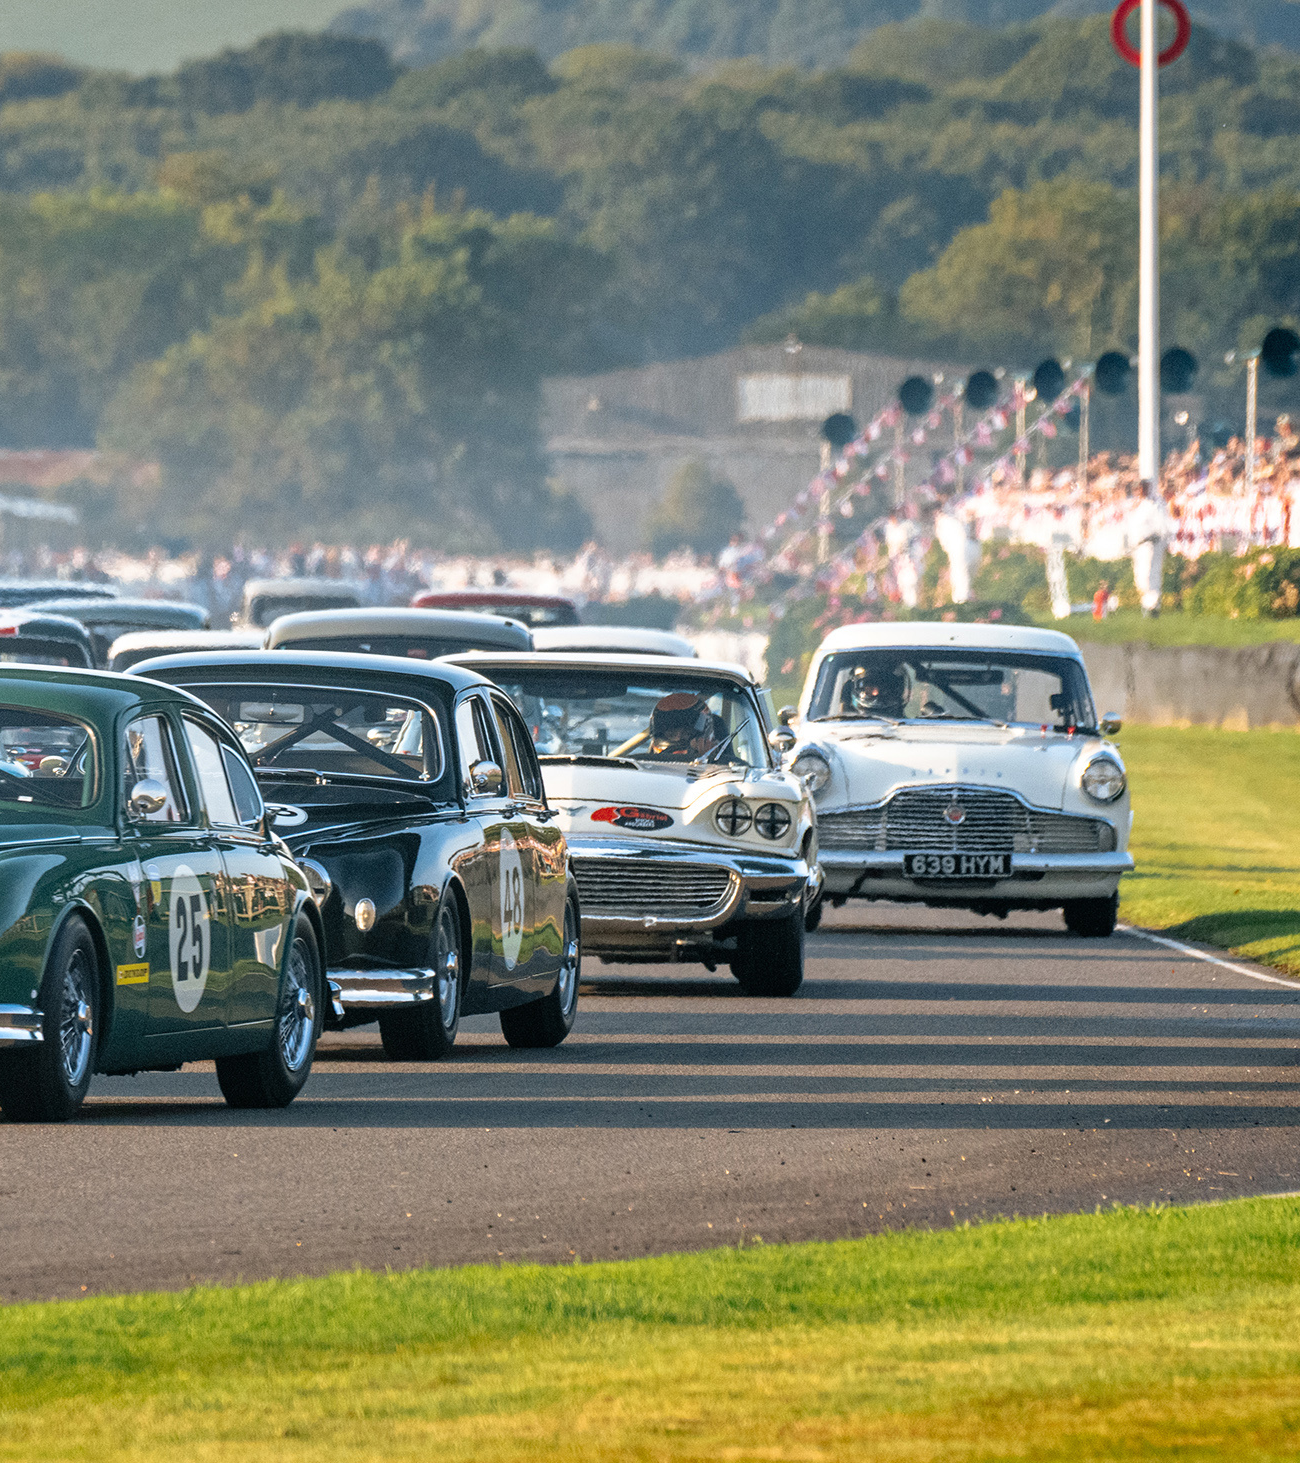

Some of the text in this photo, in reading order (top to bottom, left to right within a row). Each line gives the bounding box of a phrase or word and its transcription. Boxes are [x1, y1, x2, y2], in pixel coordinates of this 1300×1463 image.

[912, 855, 1004, 874] 639 HYM
[176, 894, 203, 982] 25
[504, 866, 522, 938] 48
